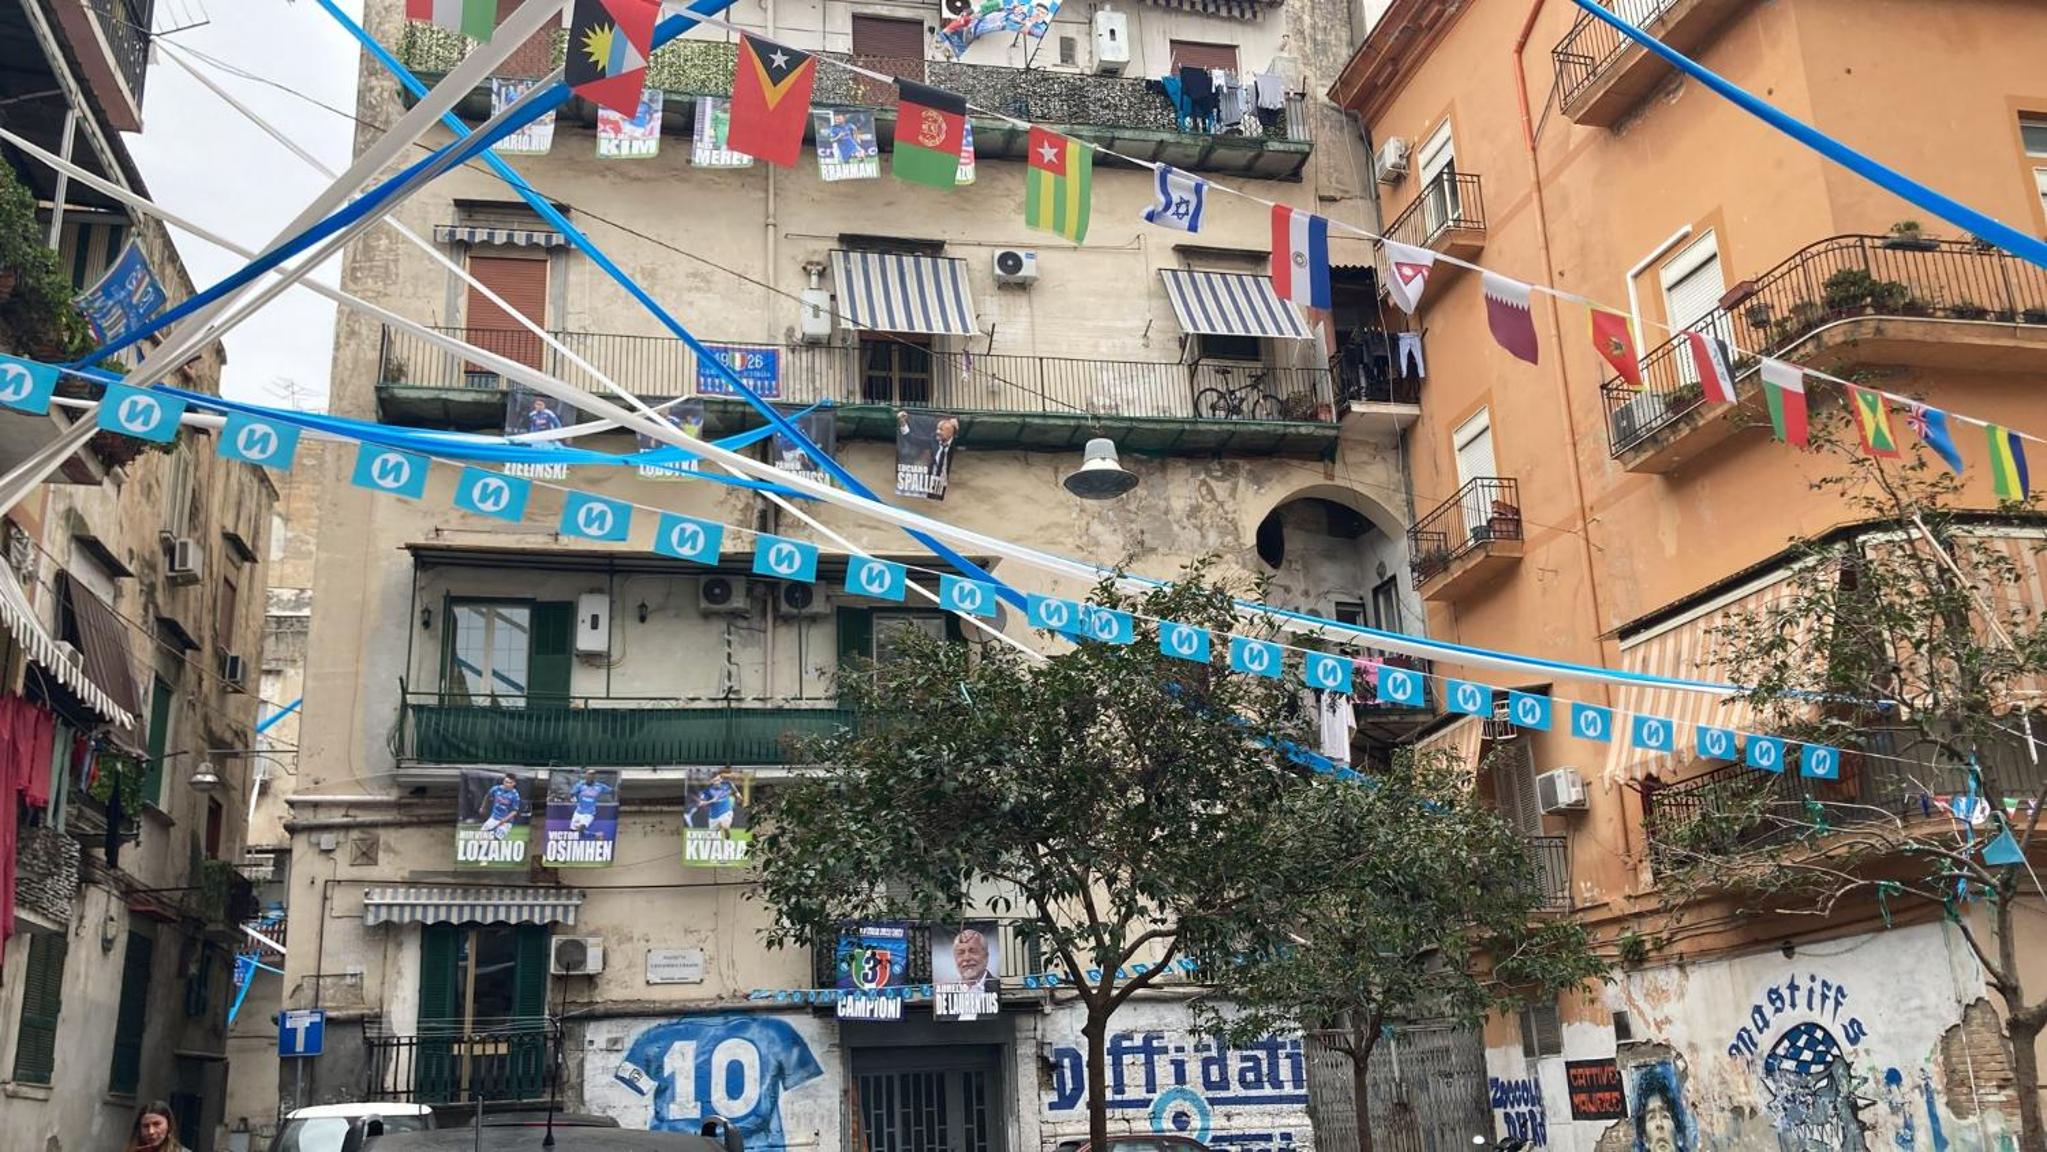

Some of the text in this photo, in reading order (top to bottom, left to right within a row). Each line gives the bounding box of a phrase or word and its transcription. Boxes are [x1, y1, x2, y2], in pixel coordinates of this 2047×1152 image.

[600, 138, 655, 155] KIM
[747, 354, 764, 369] 26
[548, 831, 580, 841] VICTOR
[457, 840, 526, 862] LOZANO
[546, 840, 613, 862] OSIMHEN
[837, 994, 902, 1019] CAMPIONI
[663, 1037, 761, 1120] 10
[1048, 1032, 1305, 1110] Dffidati
